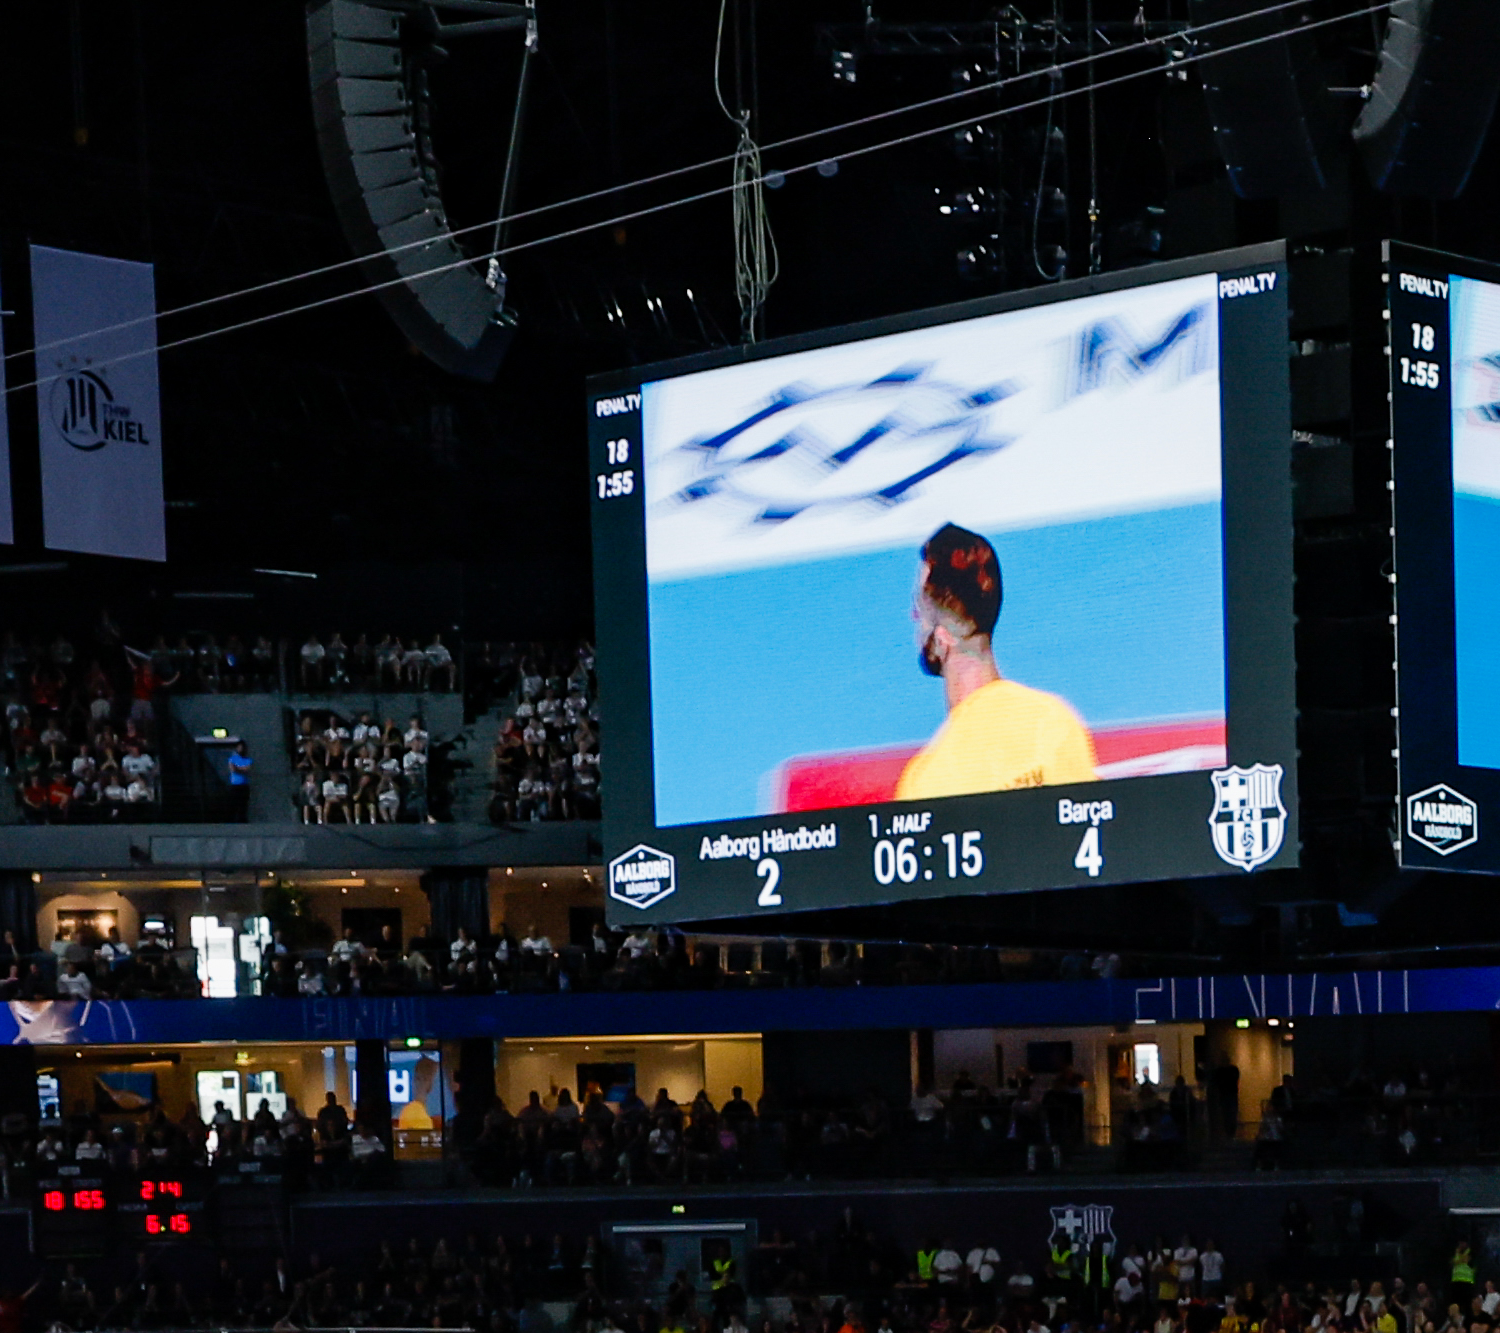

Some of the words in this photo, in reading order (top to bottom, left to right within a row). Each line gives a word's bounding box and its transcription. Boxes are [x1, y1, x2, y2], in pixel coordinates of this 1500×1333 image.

[1220, 272, 1277, 299] PENALTY
[1400, 273, 1449, 299] PENALTY
[1412, 323, 1434, 351] 18
[1400, 357, 1439, 389] 1:55
[596, 394, 642, 417] PENALTY
[105, 421, 151, 445] KIEL
[607, 438, 629, 465] 18
[597, 470, 634, 499] 1:55
[1058, 798, 1114, 827] Barça
[1413, 801, 1472, 827] AALBORG
[699, 835, 760, 860] Aalborg
[763, 823, 837, 853] Håndbold
[1075, 826, 1102, 878] 4
[615, 858, 671, 884] AALBORG
[873, 831, 983, 886] 06:15
[756, 858, 782, 907] 2
